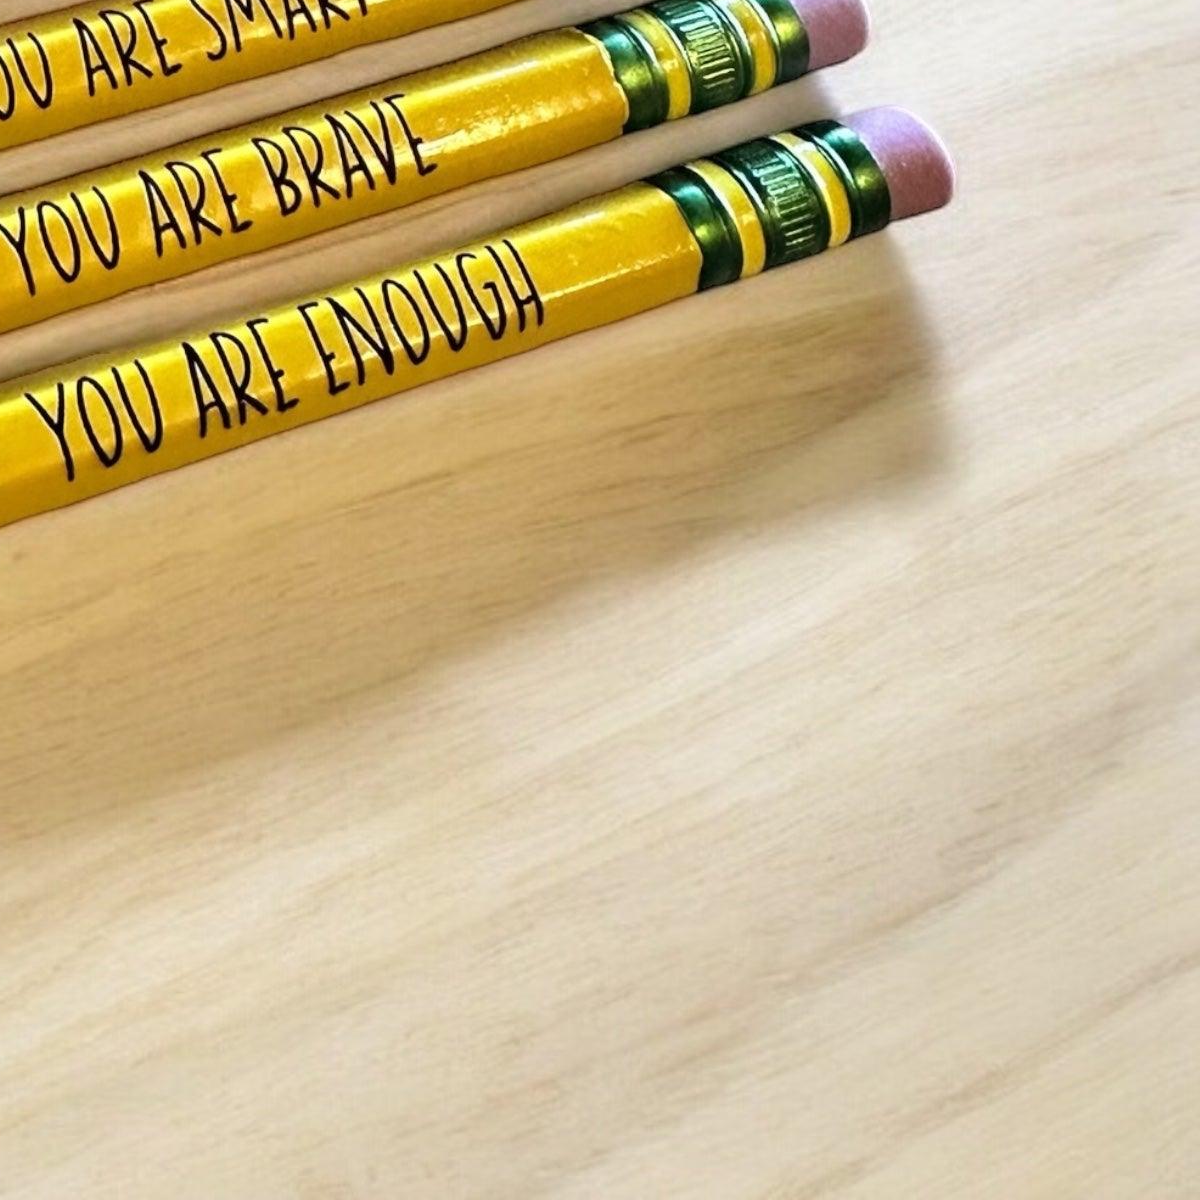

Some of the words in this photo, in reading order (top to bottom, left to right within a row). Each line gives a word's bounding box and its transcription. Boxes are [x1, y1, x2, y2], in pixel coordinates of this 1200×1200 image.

[138, 148, 253, 258] ARE
[252, 94, 438, 217] BRAVE
[25, 359, 164, 482] YOU
[181, 317, 300, 439] ARE
[297, 239, 545, 397] ENOUGH
